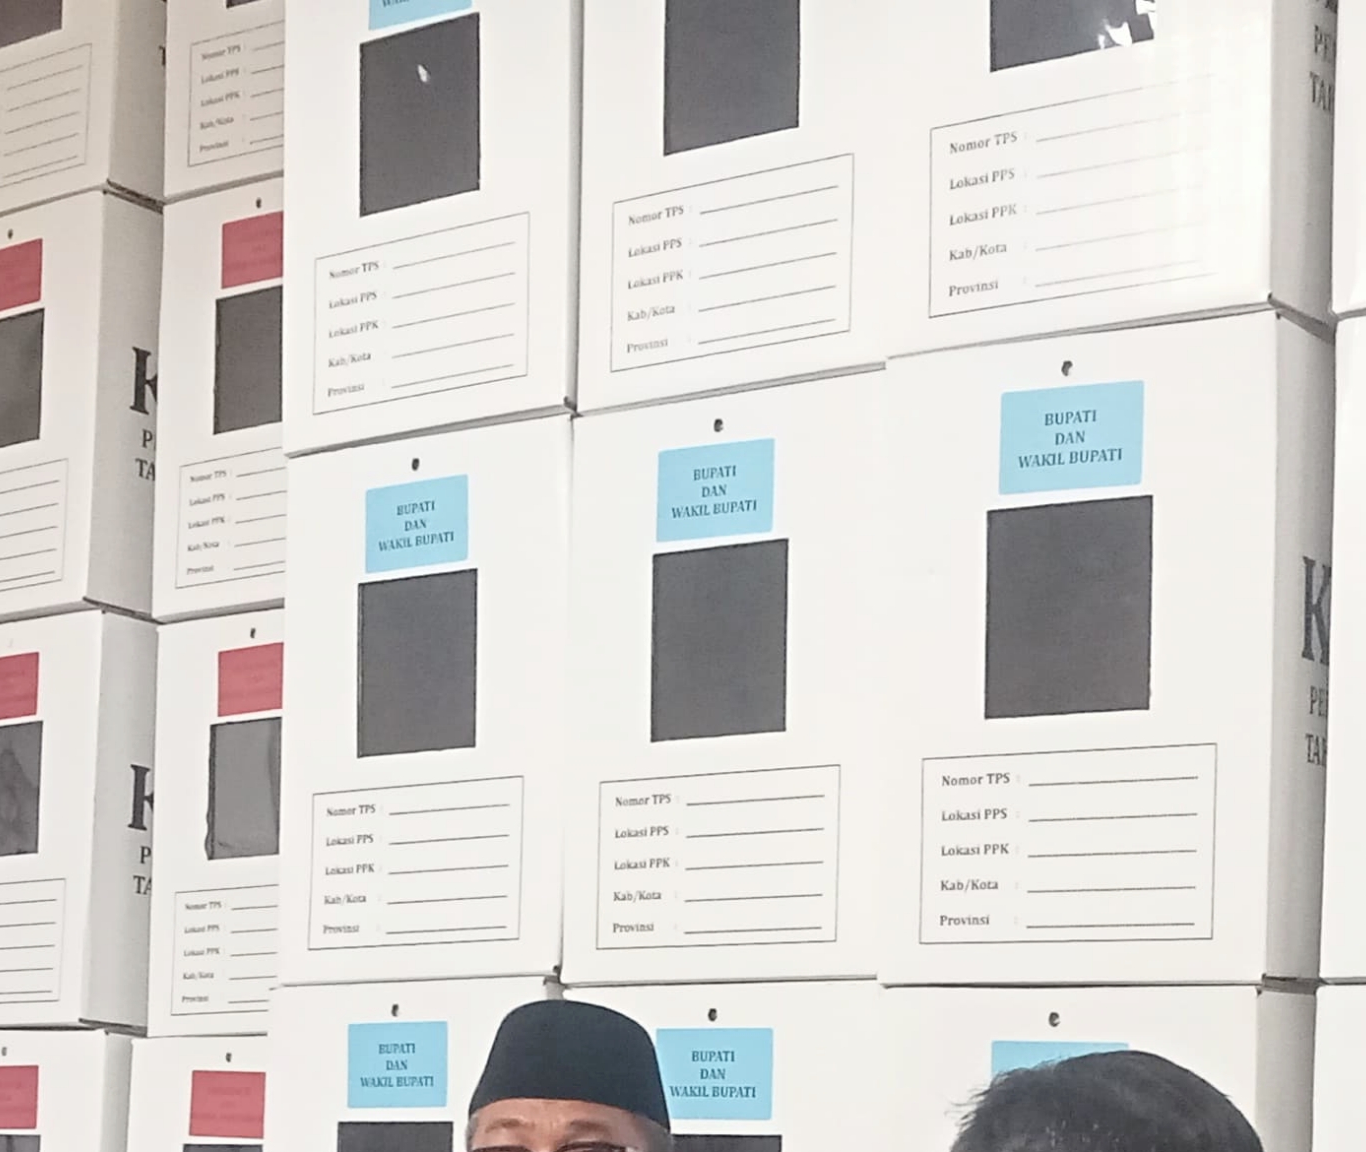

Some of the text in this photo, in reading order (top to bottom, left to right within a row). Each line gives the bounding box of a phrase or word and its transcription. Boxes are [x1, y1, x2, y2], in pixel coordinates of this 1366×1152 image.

[950, 132, 1017, 154] Nomor TPS
[950, 169, 1014, 190] Lokasi PPS
[629, 206, 684, 225] Nomor TPS
[950, 204, 1016, 226] Lokasi PPK
[628, 238, 682, 258] Lokasi PPS
[949, 244, 1006, 261] Kab/Kota
[628, 270, 683, 289] Lokasi PPK
[949, 281, 998, 297] Provinsi
[628, 306, 675, 321] Kab/Kota
[627, 339, 668, 353] Provinsi
[1045, 410, 1096, 426] BUPATI
[1055, 431, 1085, 445] DAN
[1019, 448, 1122, 468] WAKIL BUPATI
[694, 465, 736, 481] BUPATI
[702, 485, 726, 497] DAN
[397, 501, 435, 515] BUPATI
[672, 500, 756, 518] WAKIL BUPATI
[405, 519, 426, 531] DAN
[379, 531, 454, 551] WAKIL BUPATI
[942, 773, 1010, 786] Nomor TPS
[616, 794, 671, 806] Nomor TPS
[942, 808, 1007, 821] Lokasi PPS
[615, 826, 669, 838] Lokasi PPS
[941, 843, 1009, 856] Lokasi PPK
[614, 858, 670, 870] Lokasi PPK
[941, 879, 998, 891] Kab/Kota
[614, 891, 661, 902] Kab/Kota
[940, 915, 989, 926] Provinsi
[613, 923, 654, 933] Provinsi
[379, 1043, 415, 1054] BUPATI
[692, 1051, 734, 1062] BUPATI
[386, 1060, 407, 1070] DAN
[700, 1069, 725, 1079] DAN
[360, 1076, 434, 1087] WAKIL BUPATI
[670, 1086, 755, 1098] WAKIL BUPATI
